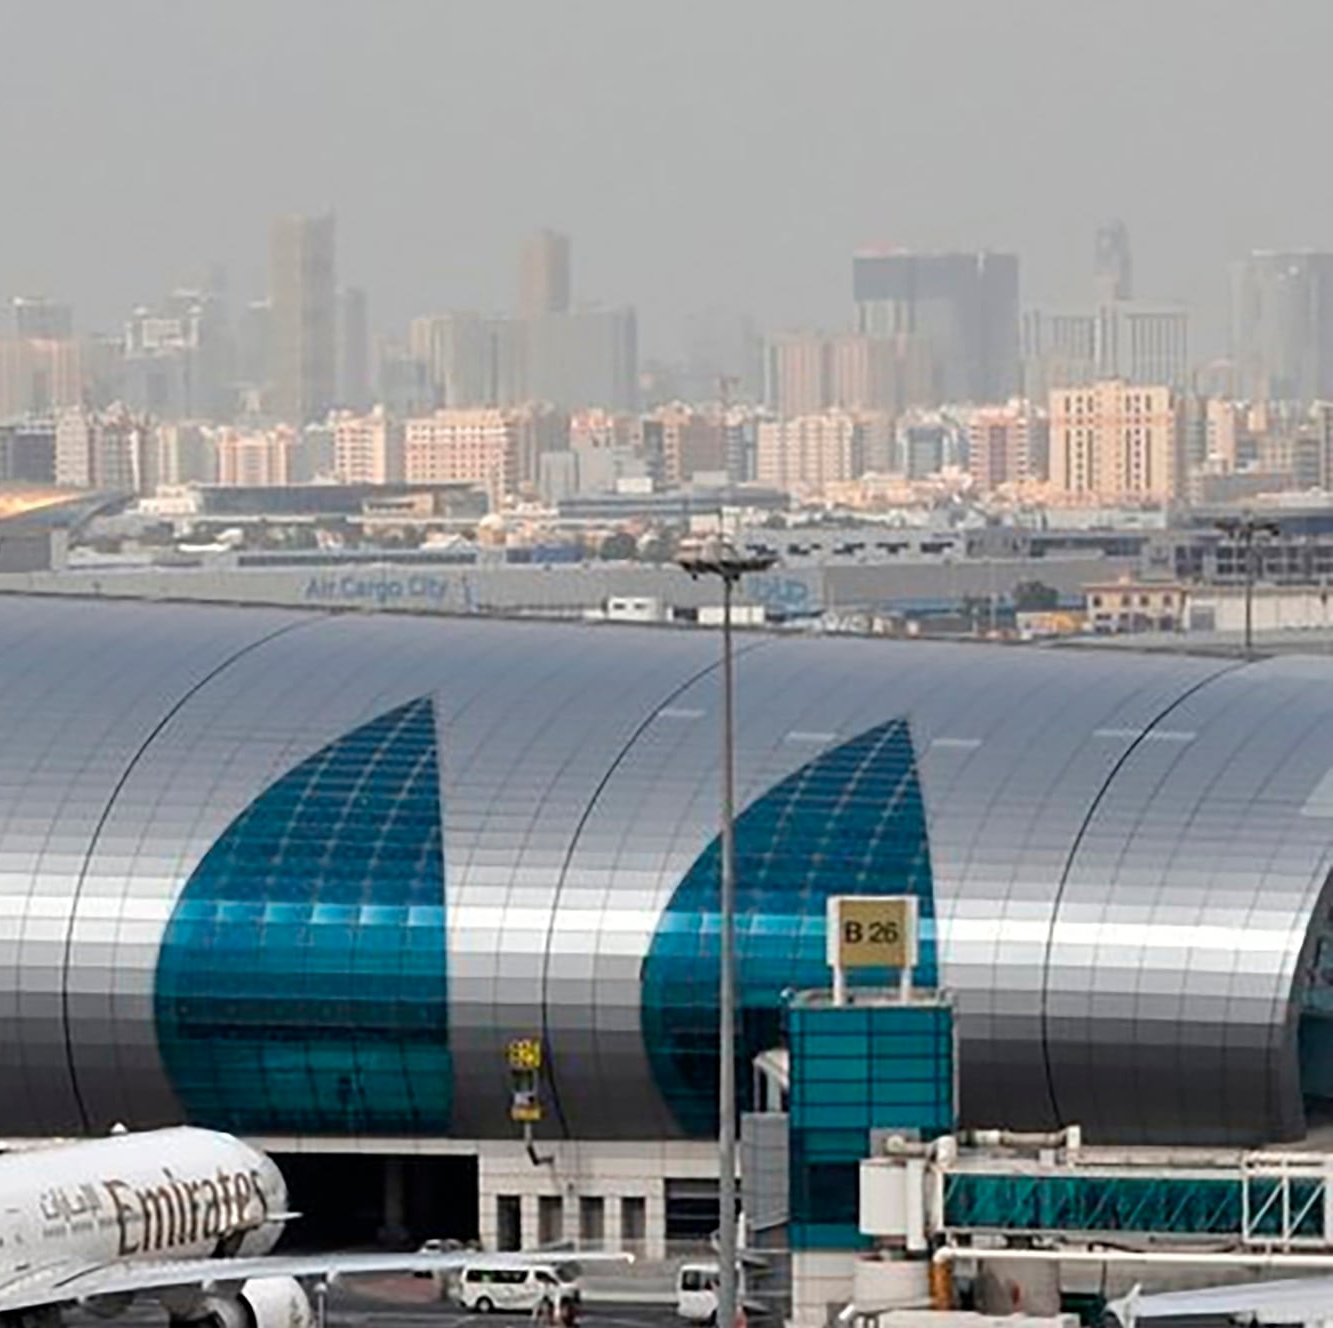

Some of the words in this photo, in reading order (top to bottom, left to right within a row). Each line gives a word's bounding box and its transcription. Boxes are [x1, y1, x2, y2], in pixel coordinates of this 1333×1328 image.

[340, 577, 403, 602] Cargo
[844, 920, 863, 945] B
[868, 921, 899, 945] 26
[103, 1166, 267, 1256] Emirates
